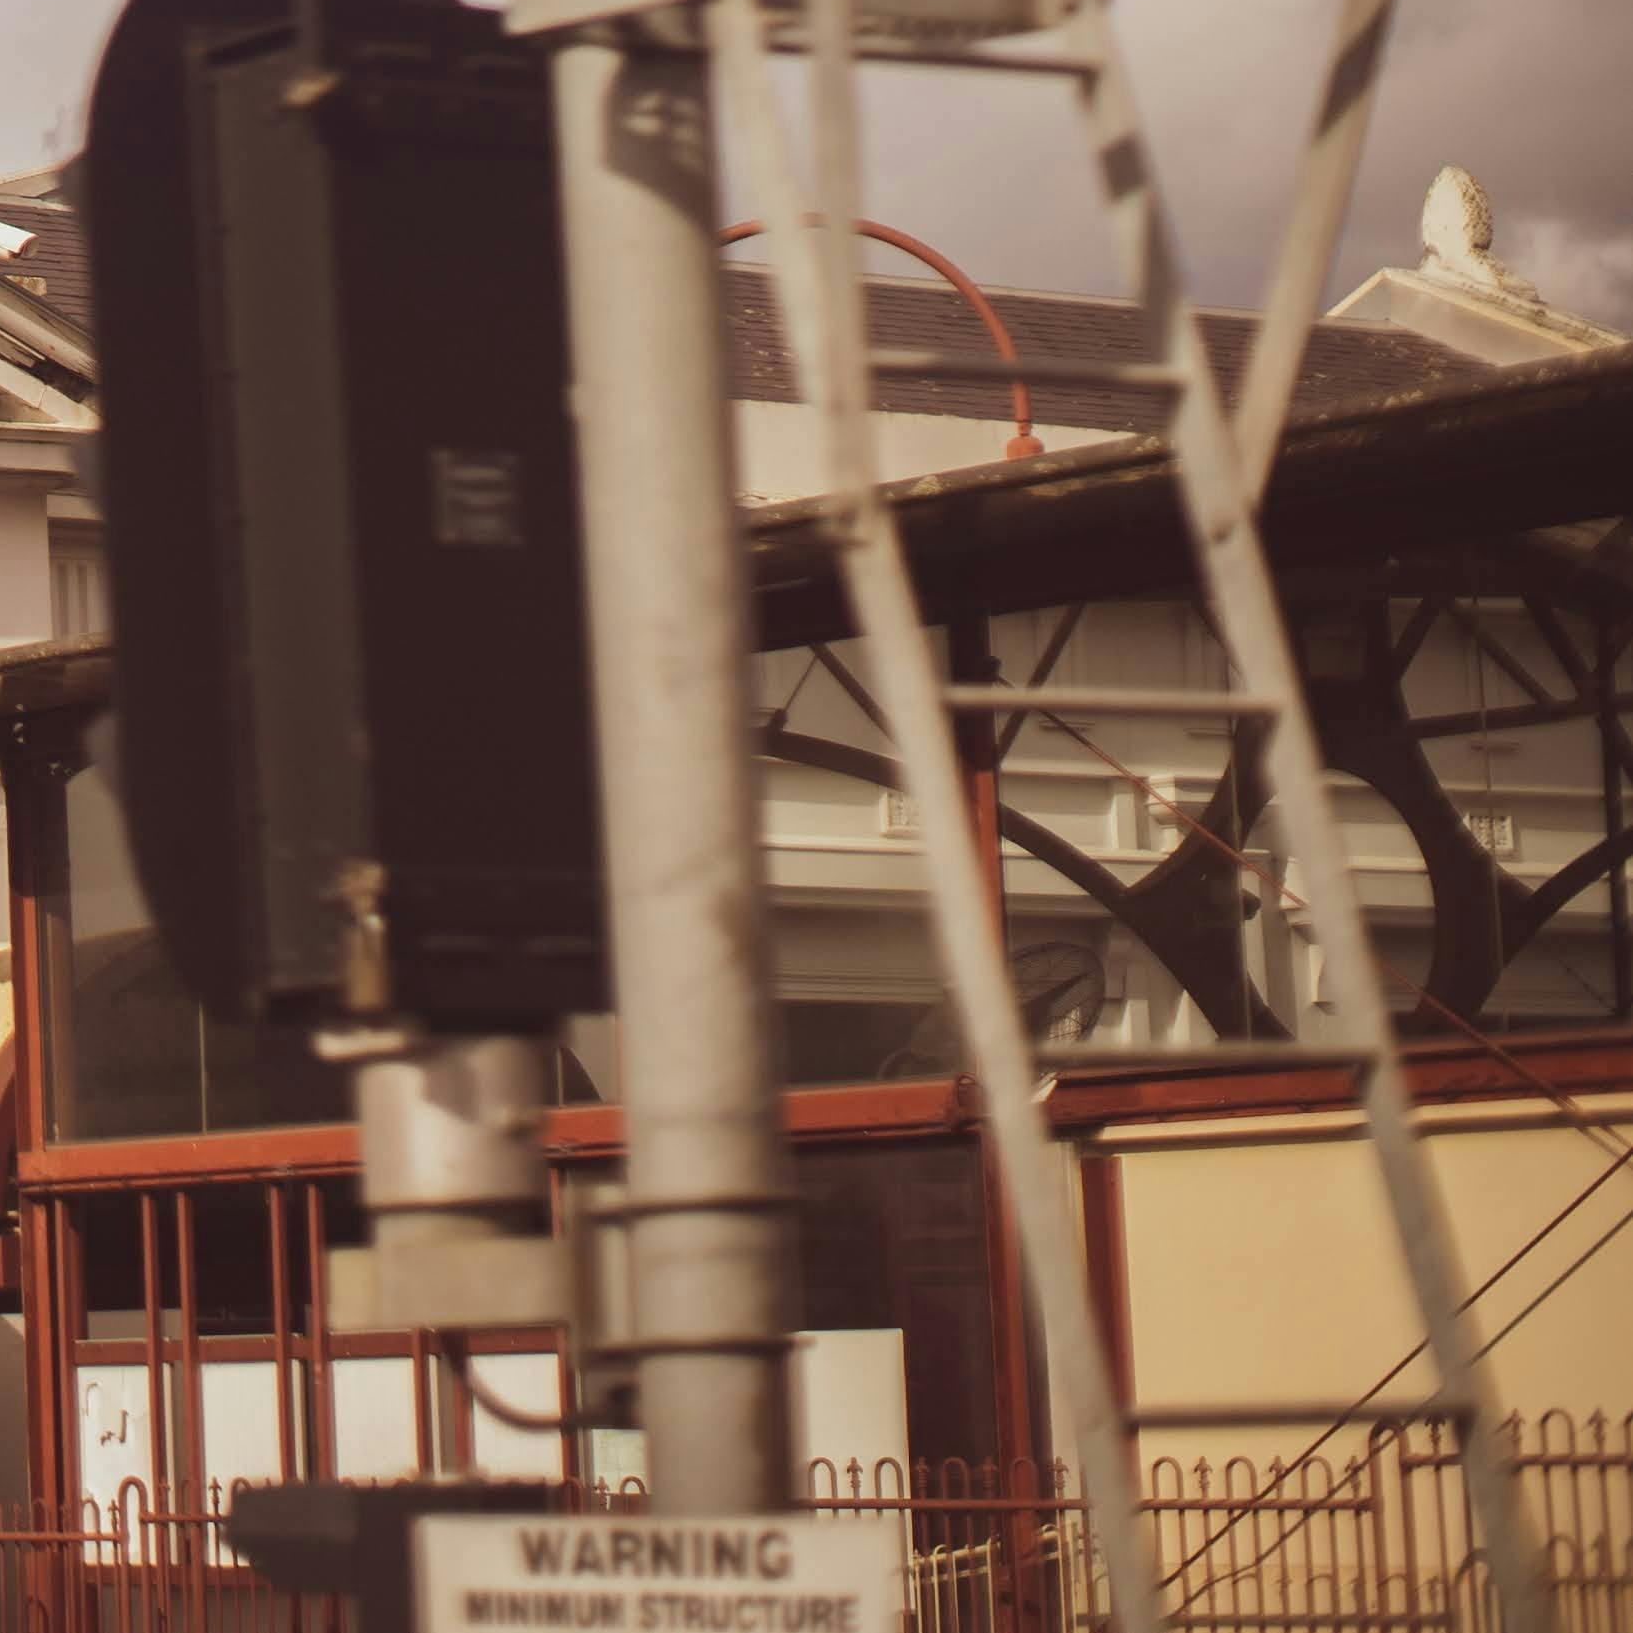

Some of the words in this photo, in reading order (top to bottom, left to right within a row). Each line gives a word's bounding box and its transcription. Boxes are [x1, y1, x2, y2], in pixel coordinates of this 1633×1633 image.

[519, 1527, 793, 1579] WARNING
[463, 1589, 625, 1628] MINIMUM
[637, 1592, 859, 1632] STRUCTURE
